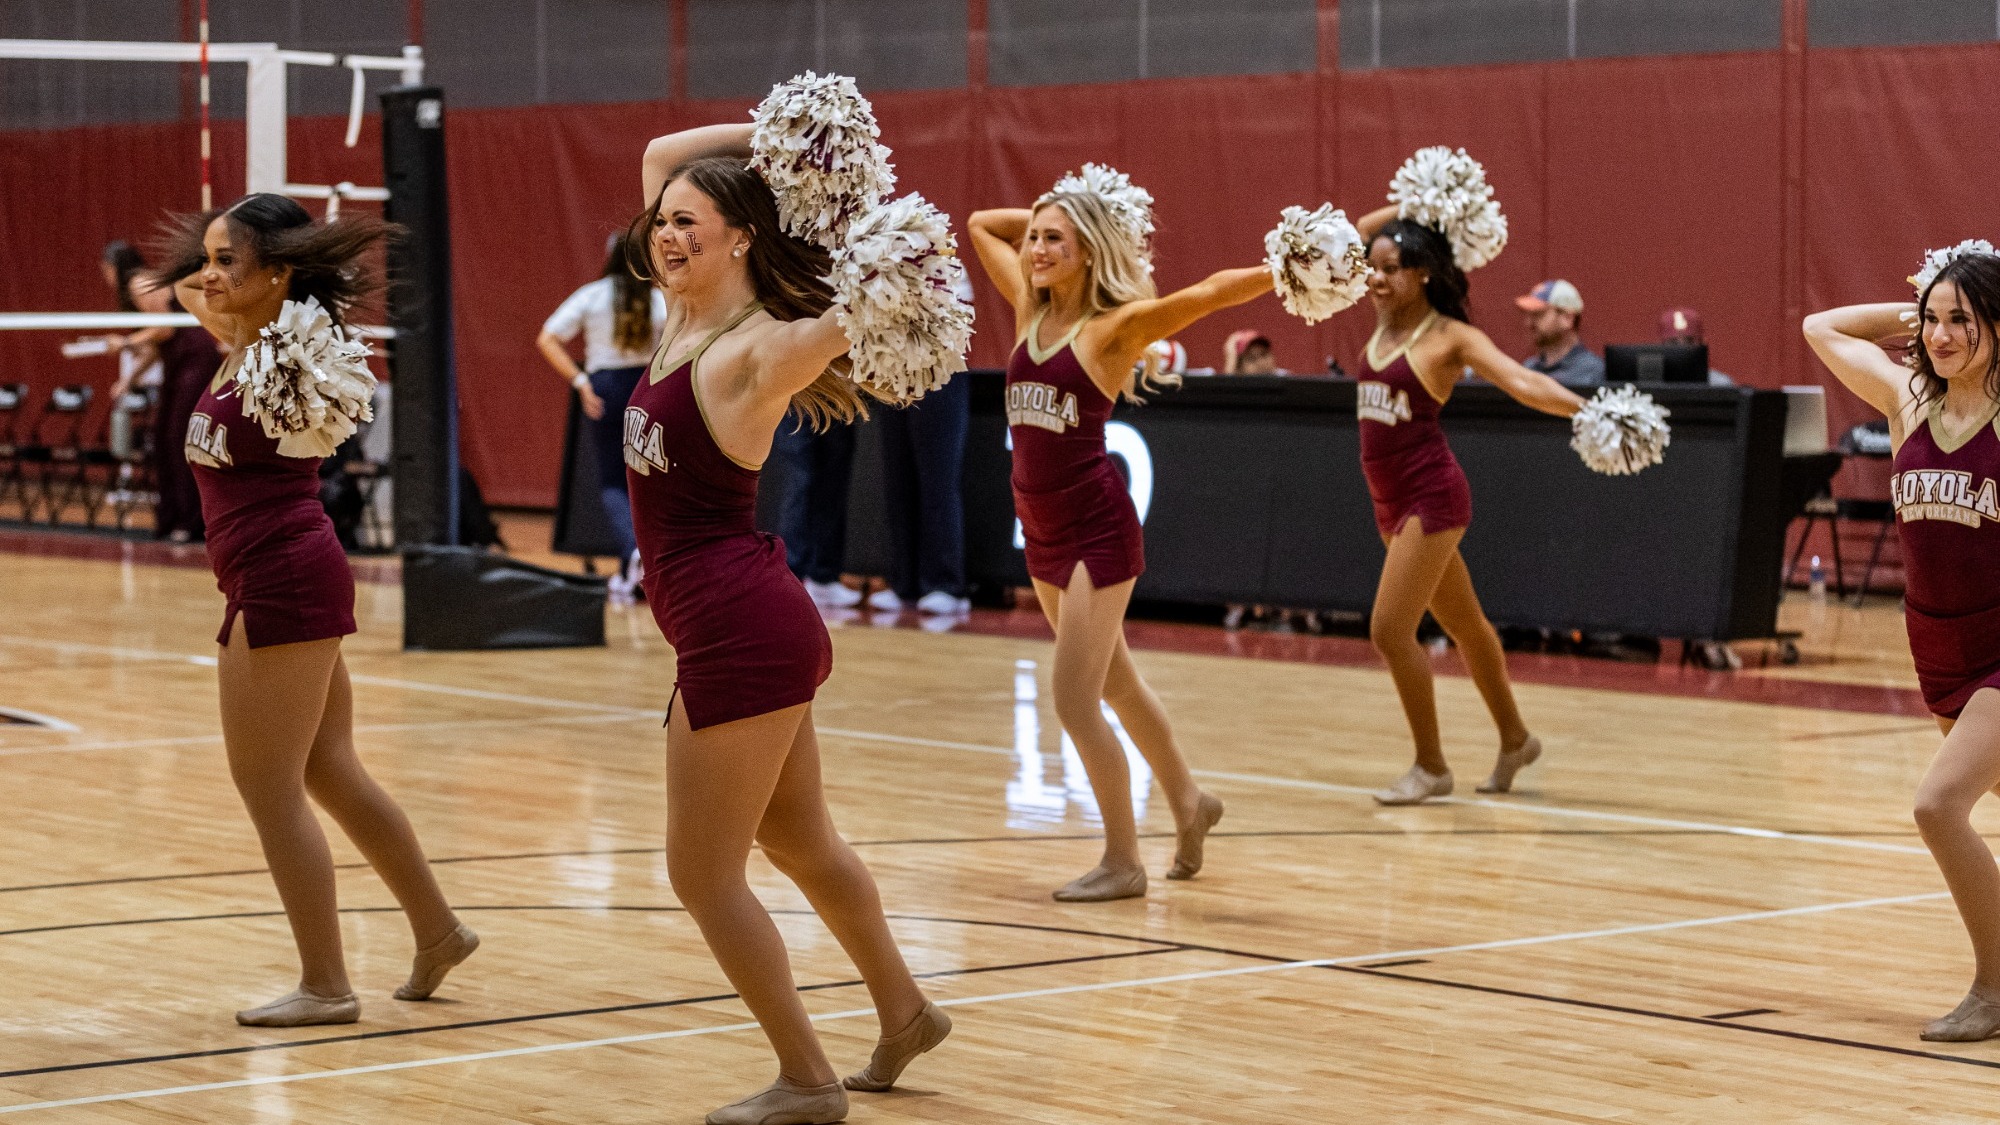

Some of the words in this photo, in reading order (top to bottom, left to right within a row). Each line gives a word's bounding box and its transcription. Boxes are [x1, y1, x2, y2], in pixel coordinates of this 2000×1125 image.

[686, 231, 703, 255] L
[1005, 382, 1080, 428] OYOLA
[1891, 469, 2000, 522] LOYOLA
[1901, 505, 1925, 523] NEW
[1925, 504, 1981, 529] ORLEANS
